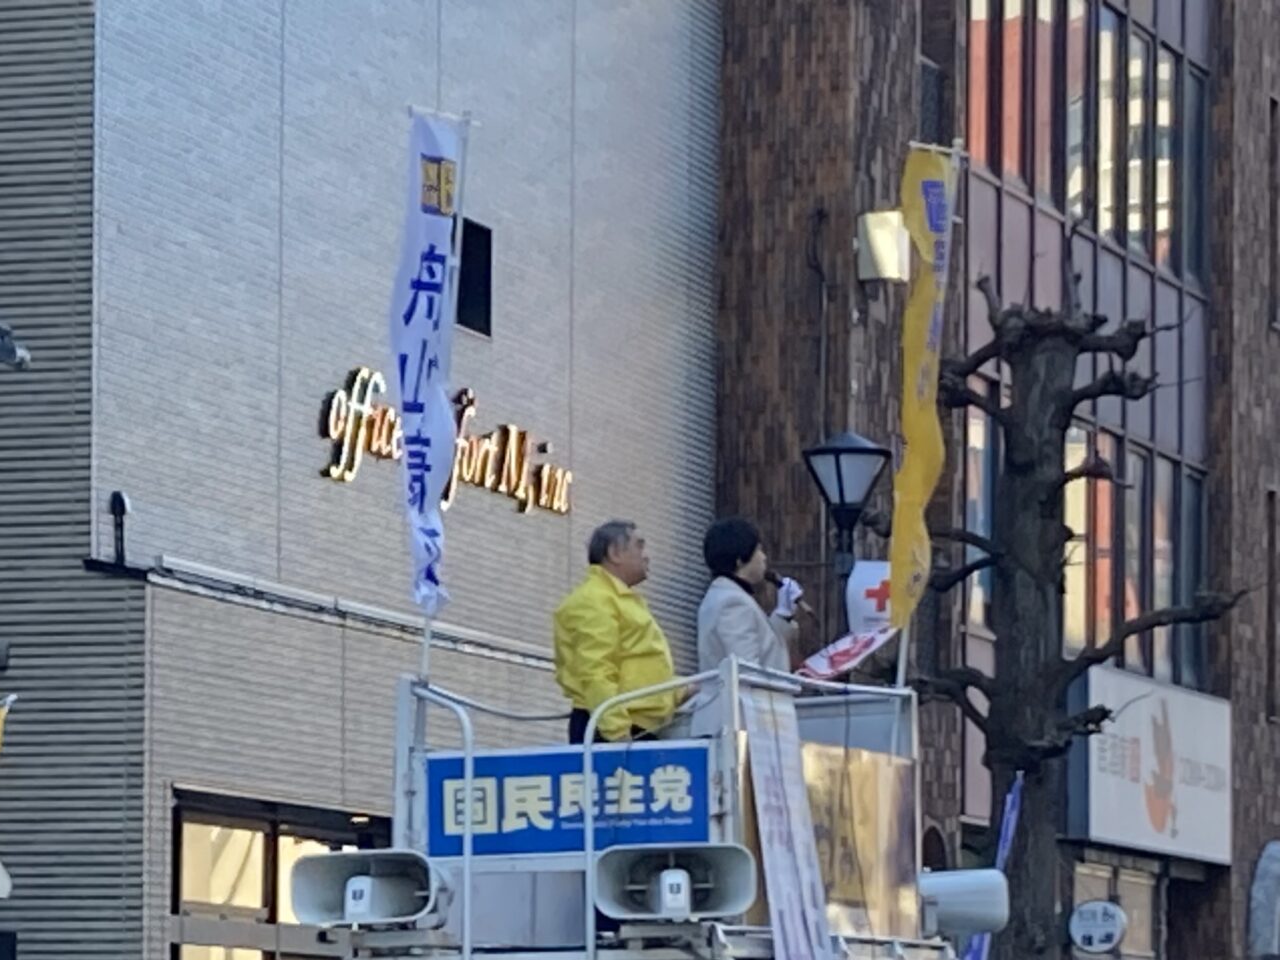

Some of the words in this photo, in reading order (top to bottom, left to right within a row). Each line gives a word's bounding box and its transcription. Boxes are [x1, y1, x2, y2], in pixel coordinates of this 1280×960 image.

[399, 243, 445, 586] 舟山康
[442, 764, 693, 836] 国民民主党
